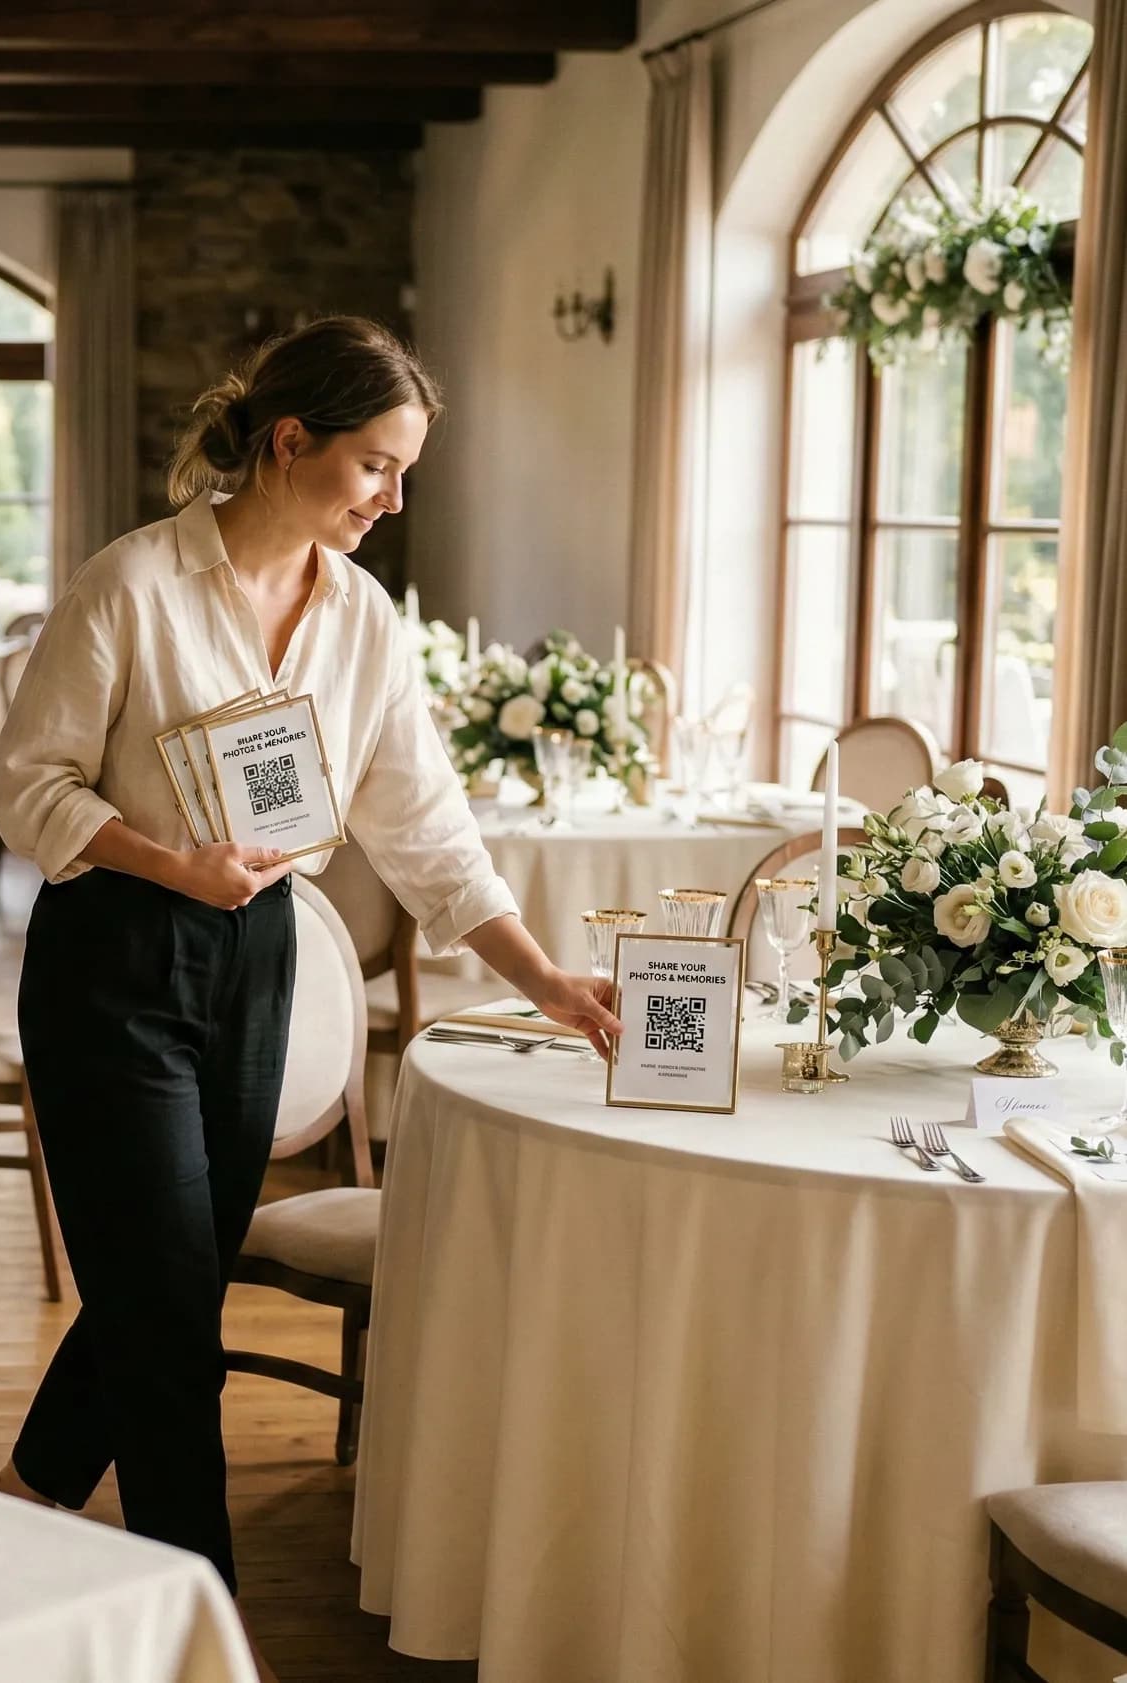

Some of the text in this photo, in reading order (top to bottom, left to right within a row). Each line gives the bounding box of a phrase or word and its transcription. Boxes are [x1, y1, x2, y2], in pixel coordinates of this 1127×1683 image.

[648, 961, 706, 972] SHARE YOUR
[629, 972, 726, 985] PHOTOS & MEMORIES
